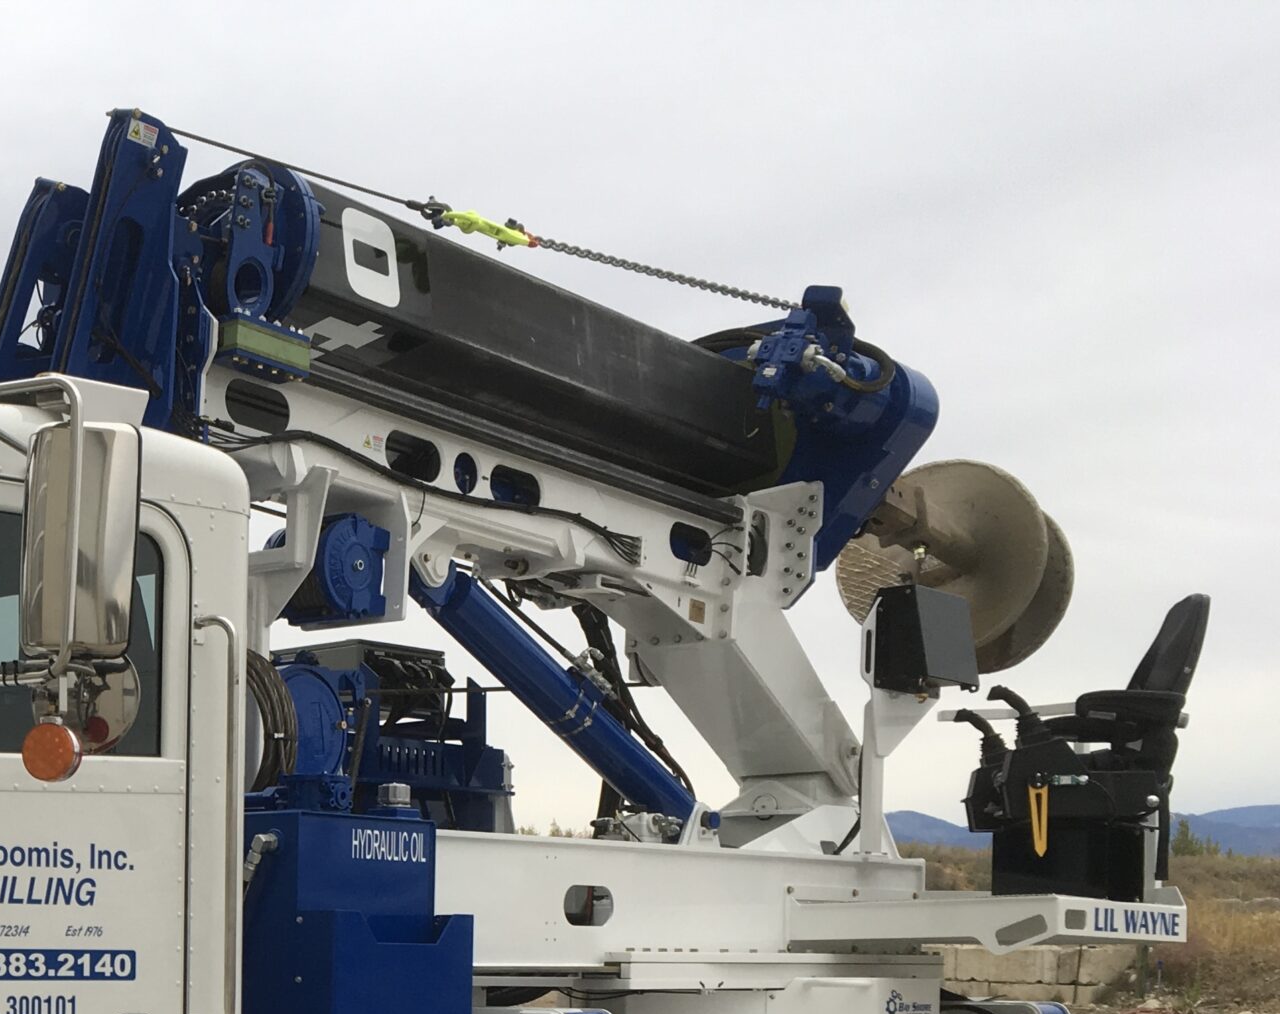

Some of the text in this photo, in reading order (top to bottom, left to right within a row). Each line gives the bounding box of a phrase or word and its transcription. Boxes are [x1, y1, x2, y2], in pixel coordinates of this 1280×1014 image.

[89, 843, 134, 871] Inc.
[351, 828, 426, 863] HYDRAULIC OIL
[64, 925, 104, 937] Est 1976
[1094, 907, 1180, 937] LIL WAYNE
